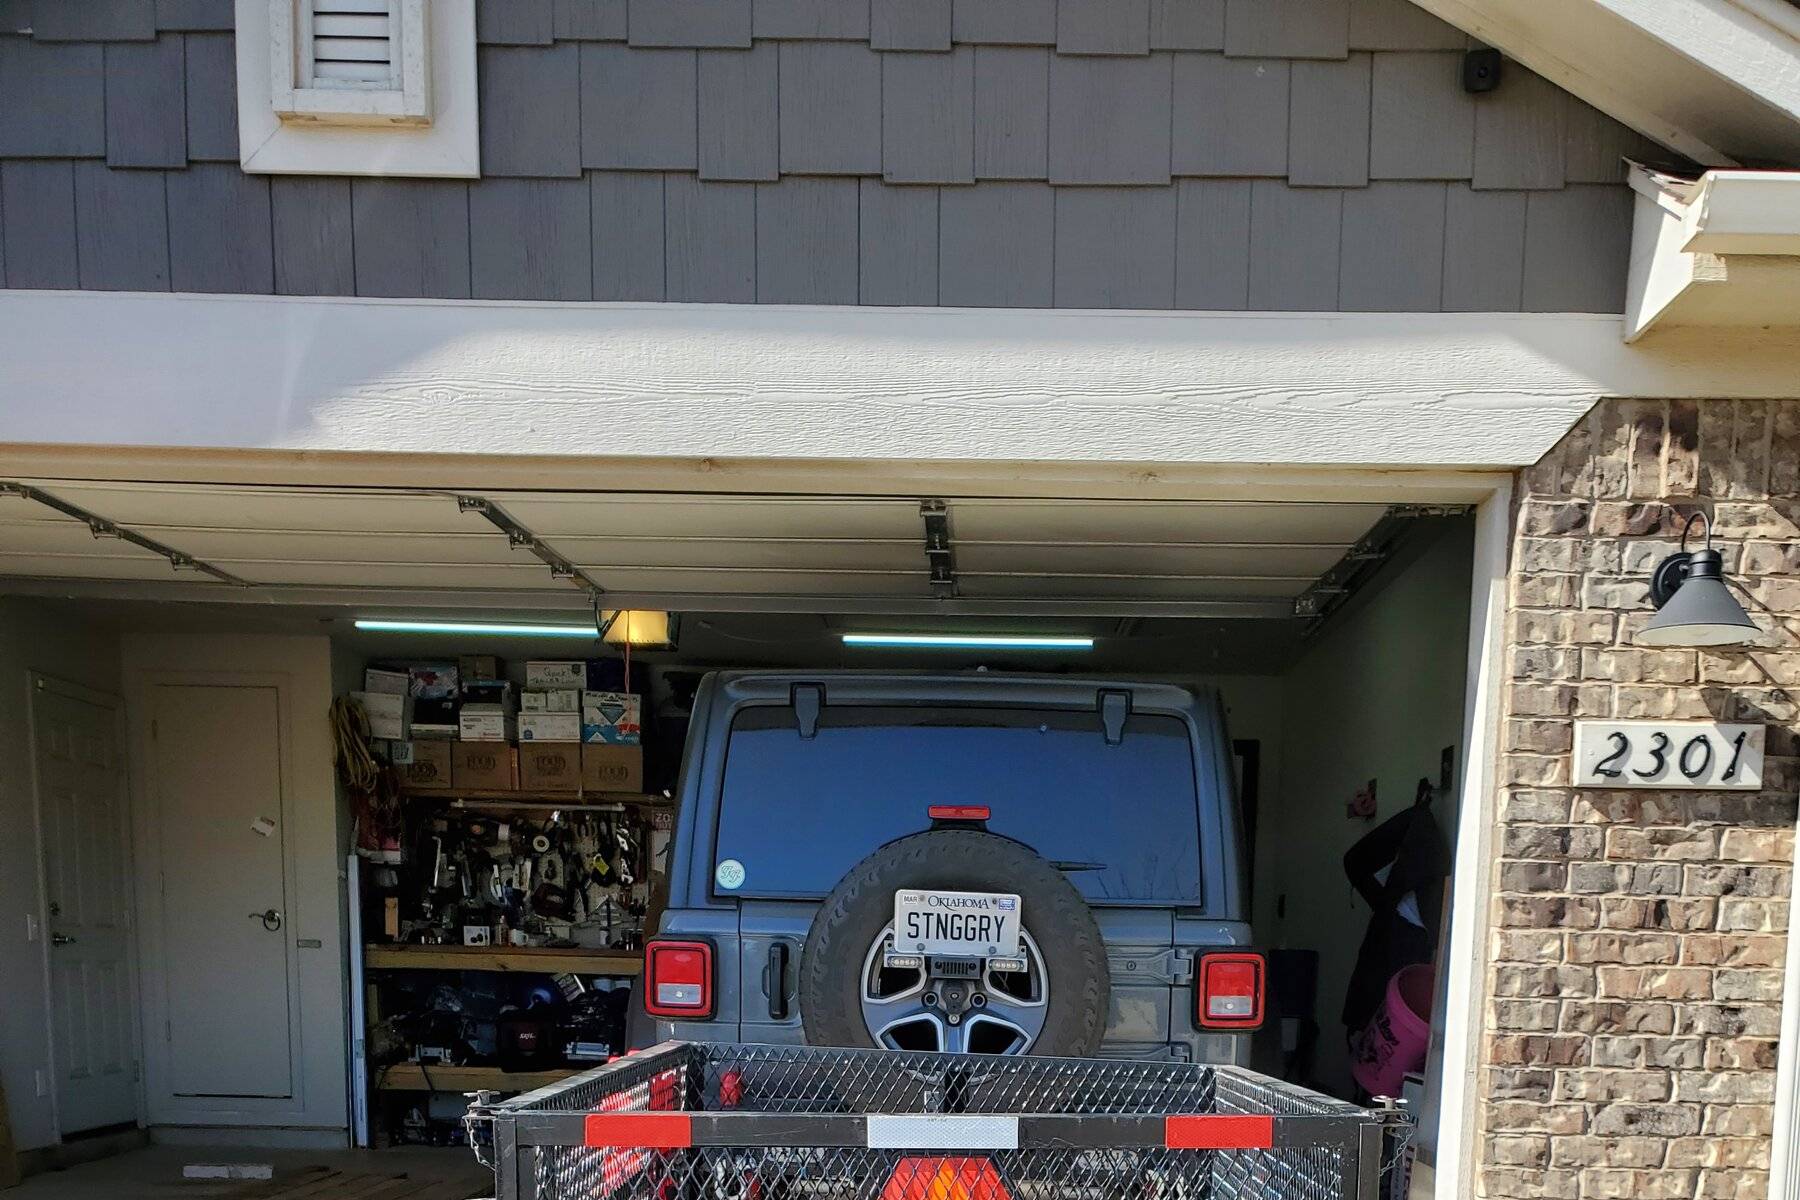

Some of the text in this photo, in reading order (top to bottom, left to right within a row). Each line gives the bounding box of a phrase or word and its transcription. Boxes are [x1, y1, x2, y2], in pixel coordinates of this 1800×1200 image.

[1592, 730, 1747, 781] 2301
[928, 895, 990, 911] OKLAHOMA
[907, 912, 1005, 942] STNGGRY
